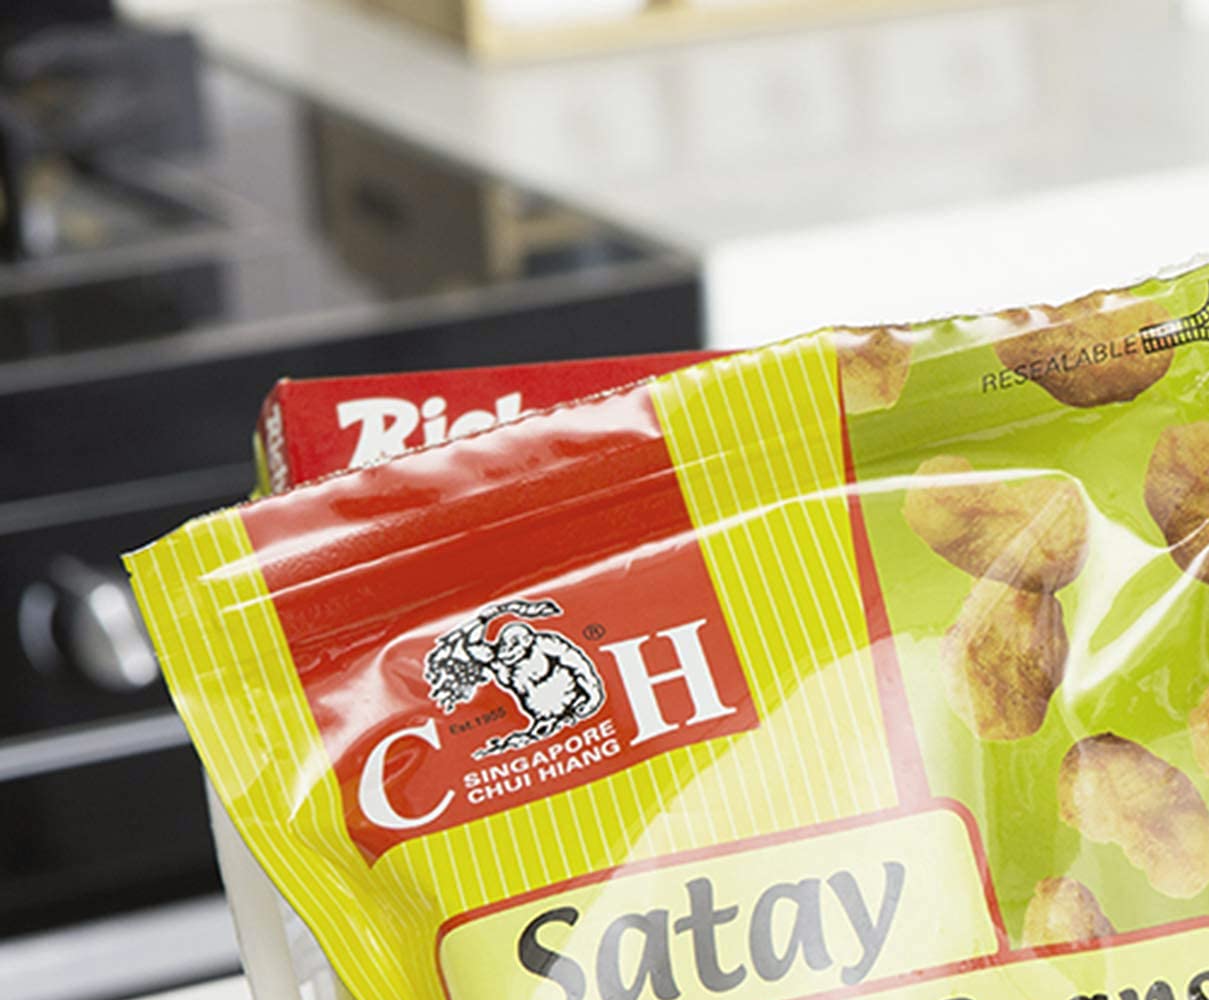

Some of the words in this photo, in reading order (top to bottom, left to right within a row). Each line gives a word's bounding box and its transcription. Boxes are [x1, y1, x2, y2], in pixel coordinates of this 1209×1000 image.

[982, 334, 1138, 393] RESEALABLE
[463, 719, 617, 790] SINGAPORE
[466, 772, 532, 805] CHUI
[539, 738, 622, 783] HIANG
